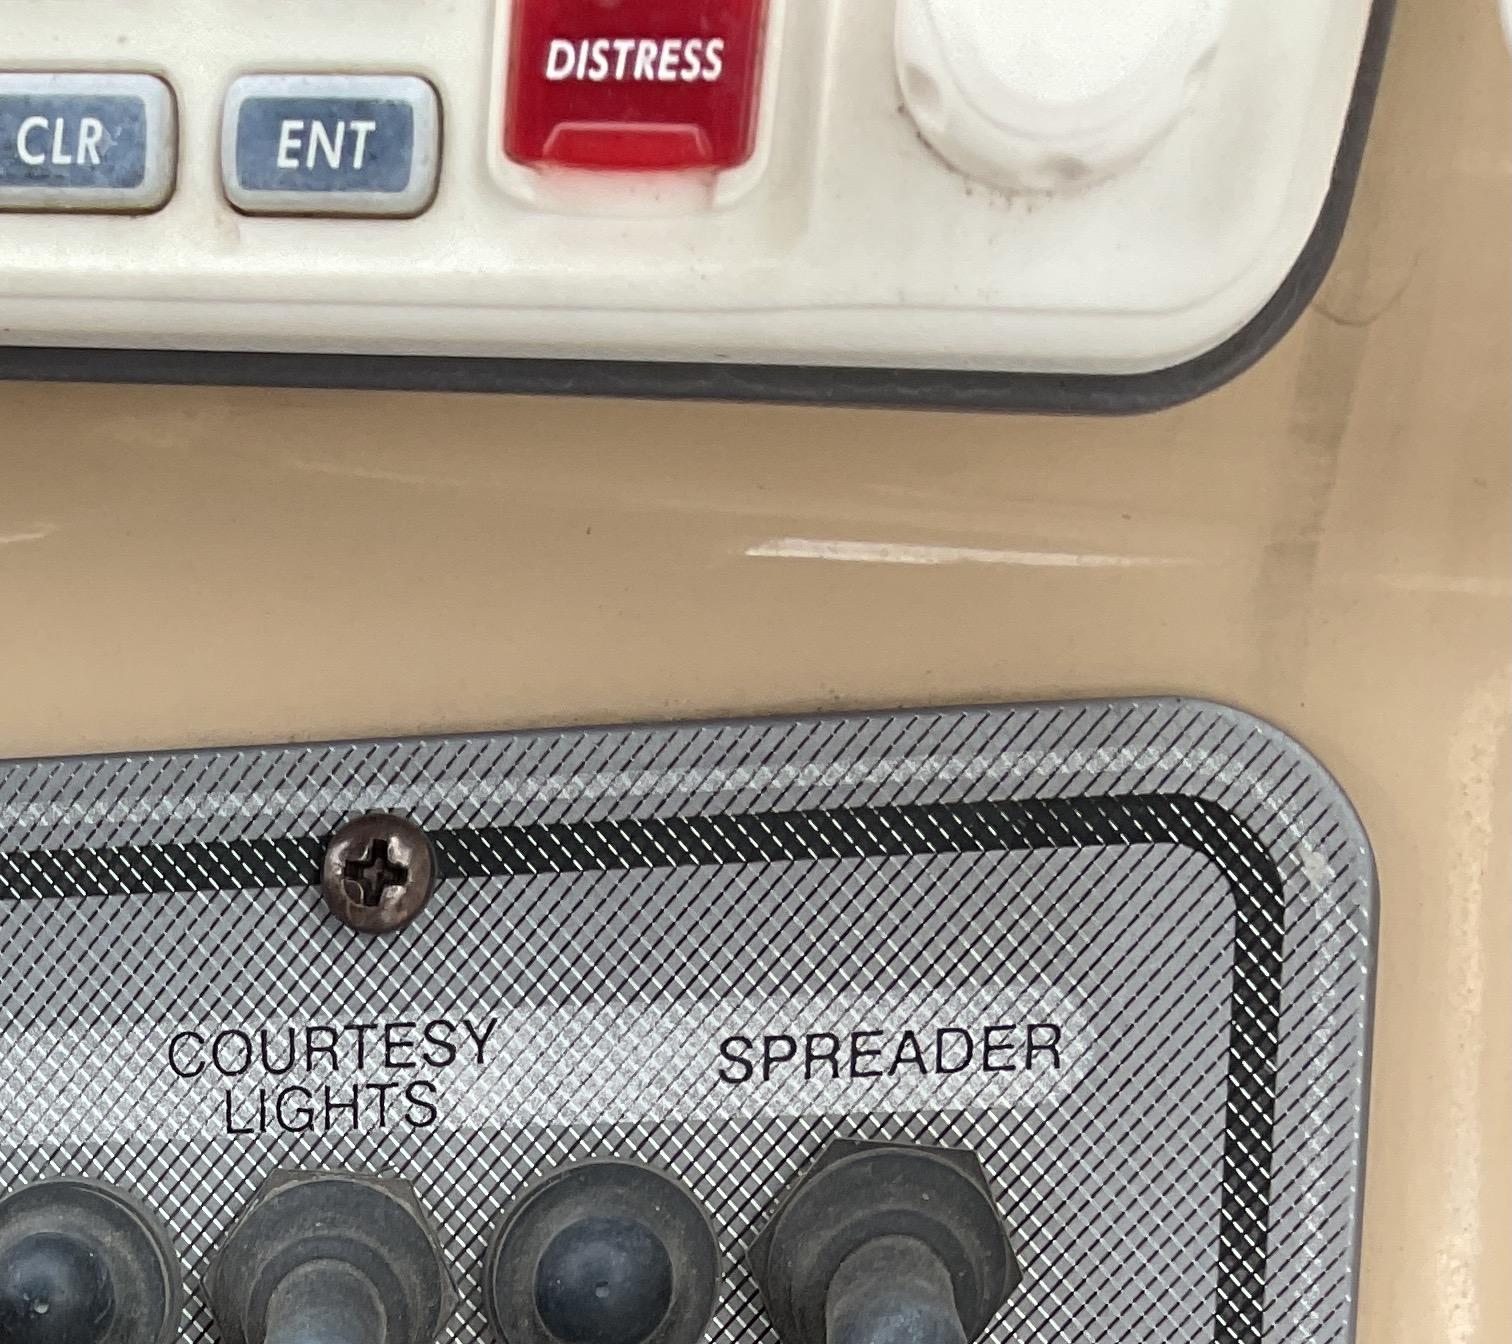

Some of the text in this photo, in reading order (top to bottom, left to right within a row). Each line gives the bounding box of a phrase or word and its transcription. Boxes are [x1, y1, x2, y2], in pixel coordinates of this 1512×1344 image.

[545, 38, 724, 81] DISTRESS
[17, 117, 103, 165] CLR
[277, 119, 376, 169] ENT
[168, 1017, 498, 1079] COURTESY
[717, 1023, 1064, 1085] SPREADER
[224, 1079, 439, 1134] LIGHTS
